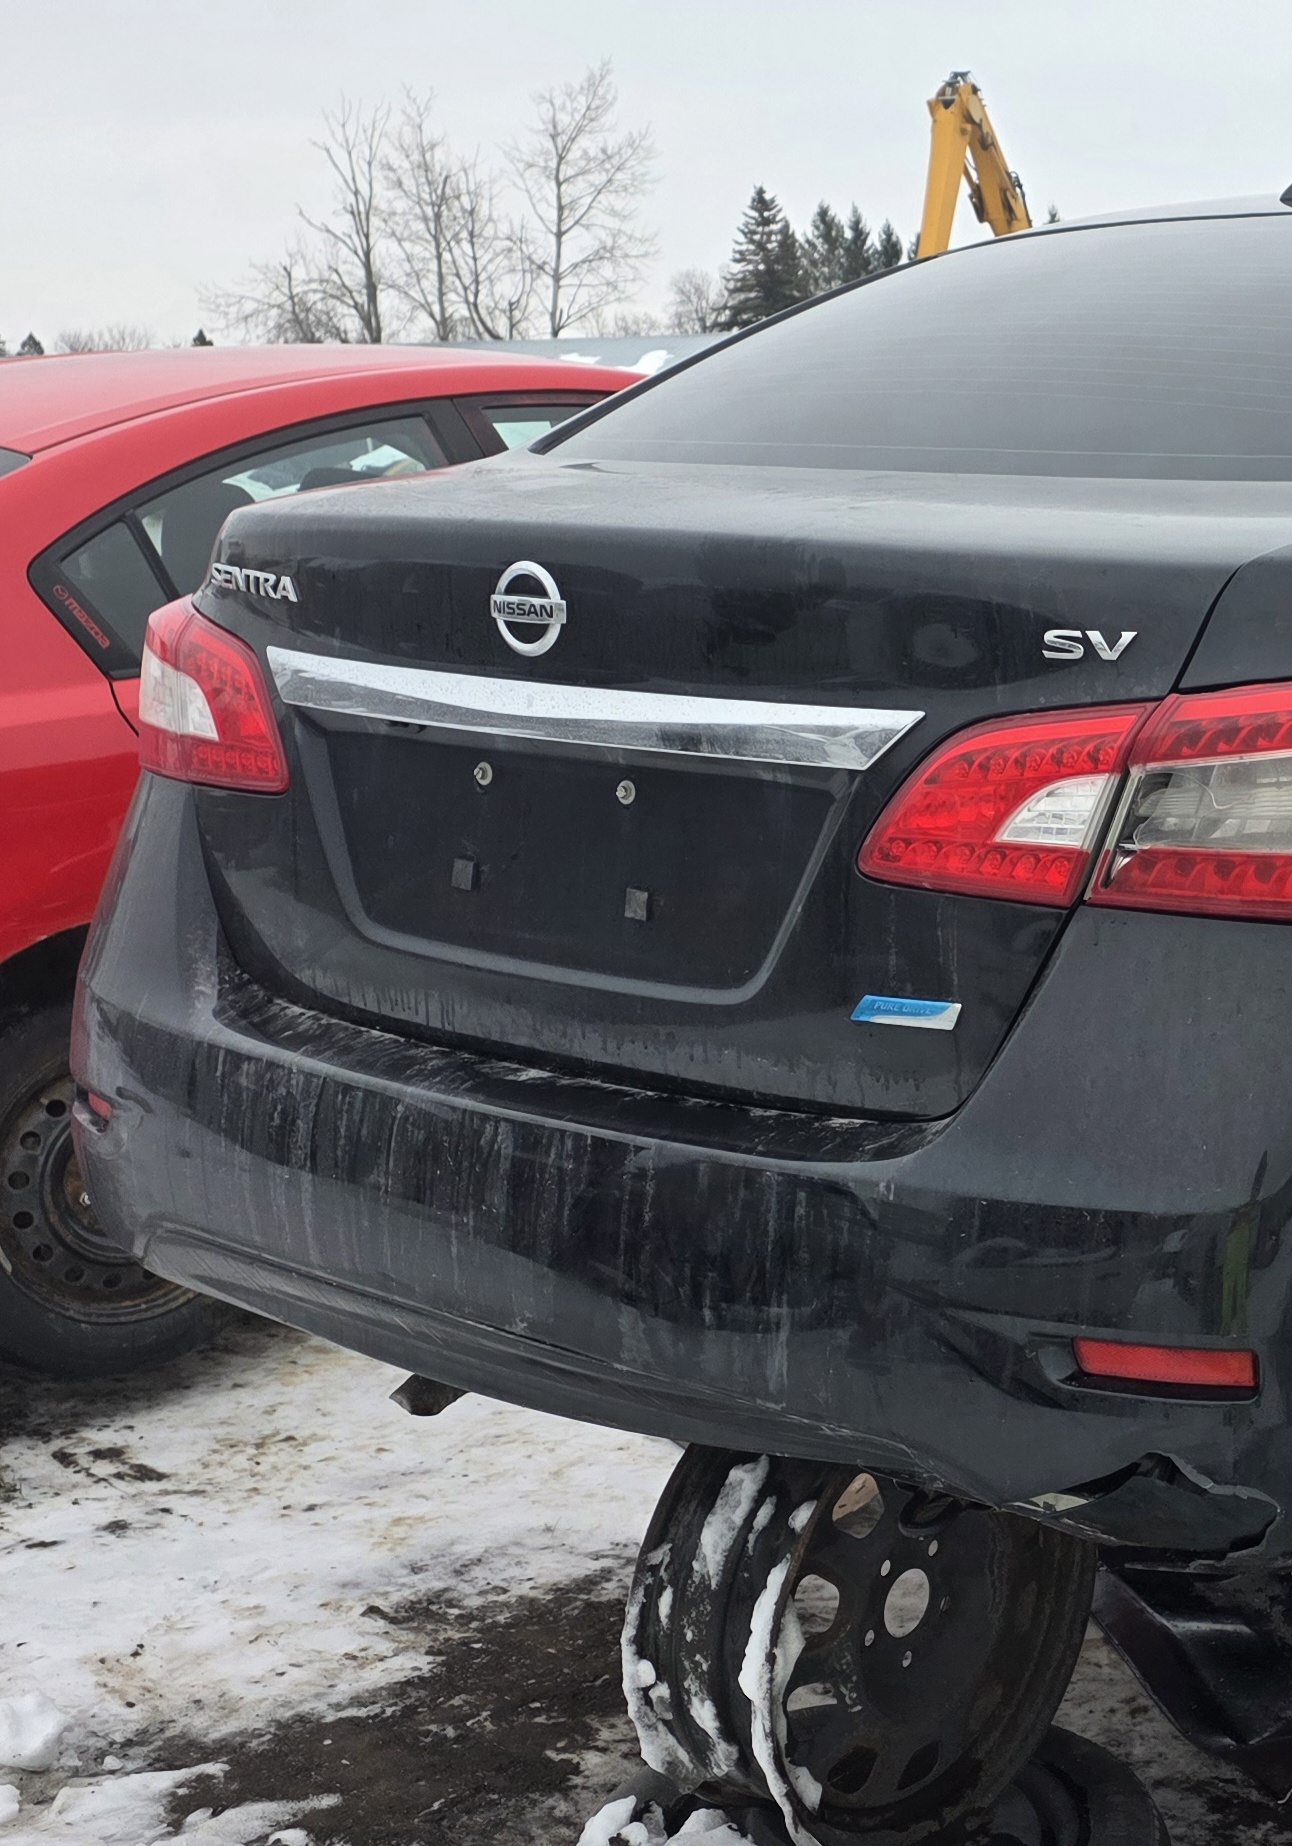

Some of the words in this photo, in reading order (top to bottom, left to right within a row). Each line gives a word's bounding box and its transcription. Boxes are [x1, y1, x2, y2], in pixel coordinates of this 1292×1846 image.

[210, 563, 300, 602] SENTRA
[493, 600, 554, 619] NISSAN
[1043, 629, 1138, 661] SV
[874, 1001, 900, 1012] PURE
